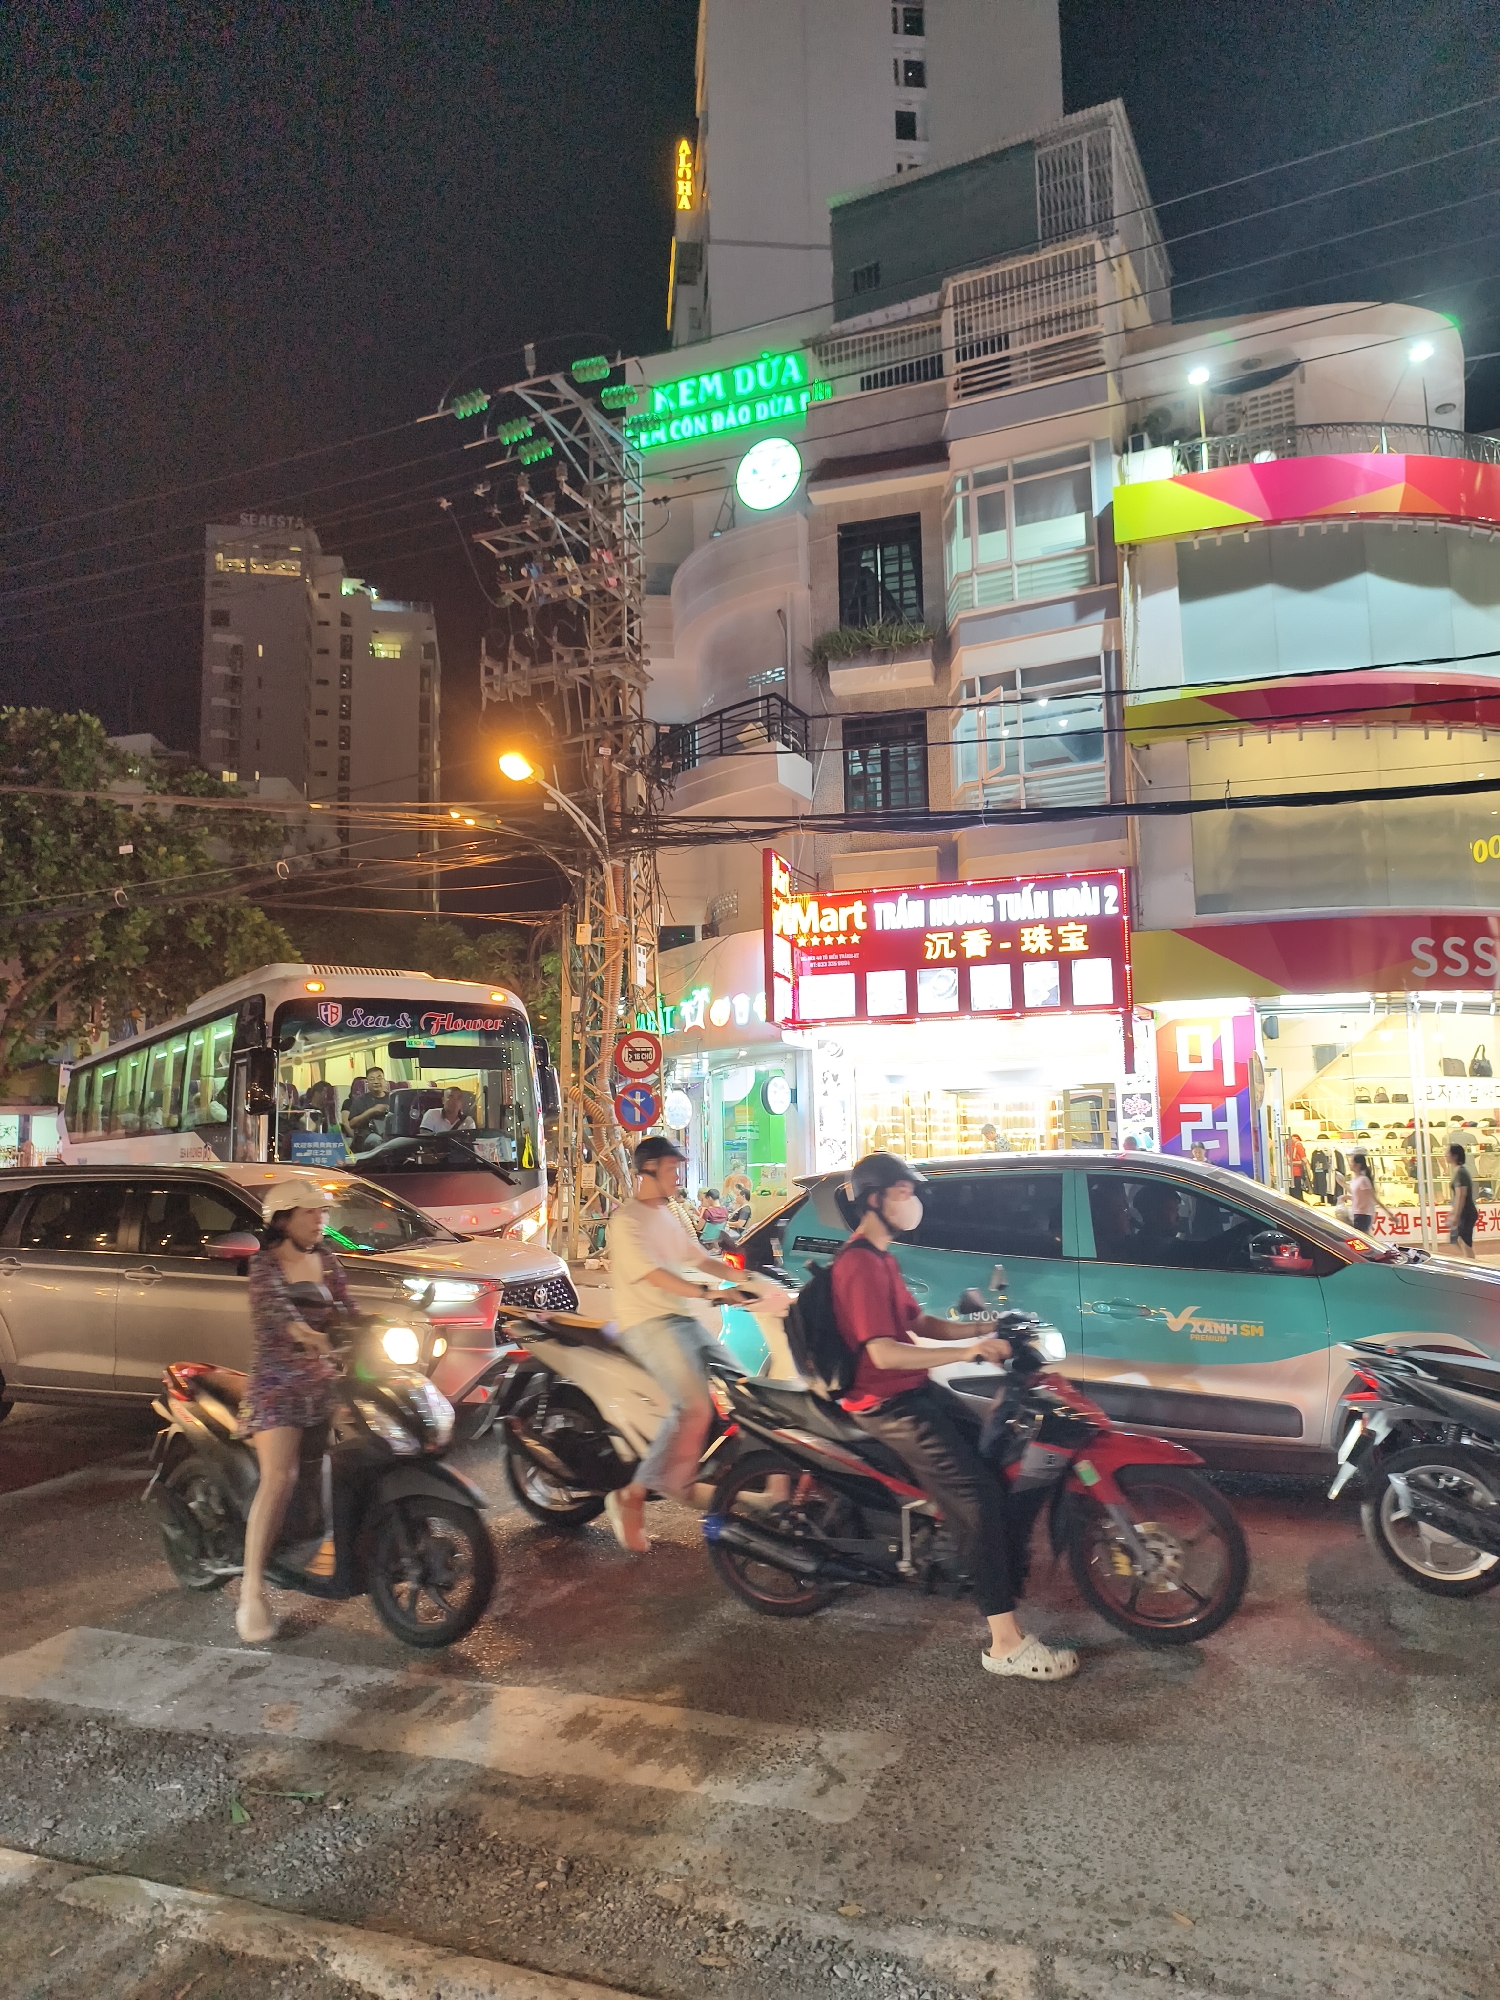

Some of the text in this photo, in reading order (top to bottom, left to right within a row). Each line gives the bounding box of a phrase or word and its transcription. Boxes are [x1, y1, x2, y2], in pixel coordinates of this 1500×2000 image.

[653, 371, 727, 414] KEM
[734, 352, 803, 396] DỪA
[669, 413, 708, 441] CÔN
[239, 512, 304, 530] SEAESTA
[1103, 885, 1119, 915] 2
[347, 1007, 392, 1028] Sea
[395, 1012, 413, 1029] &
[419, 1011, 504, 1036] Flower
[1189, 1333, 1228, 1343] PREMIUM
[1190, 1321, 1264, 1337] XANH SM
